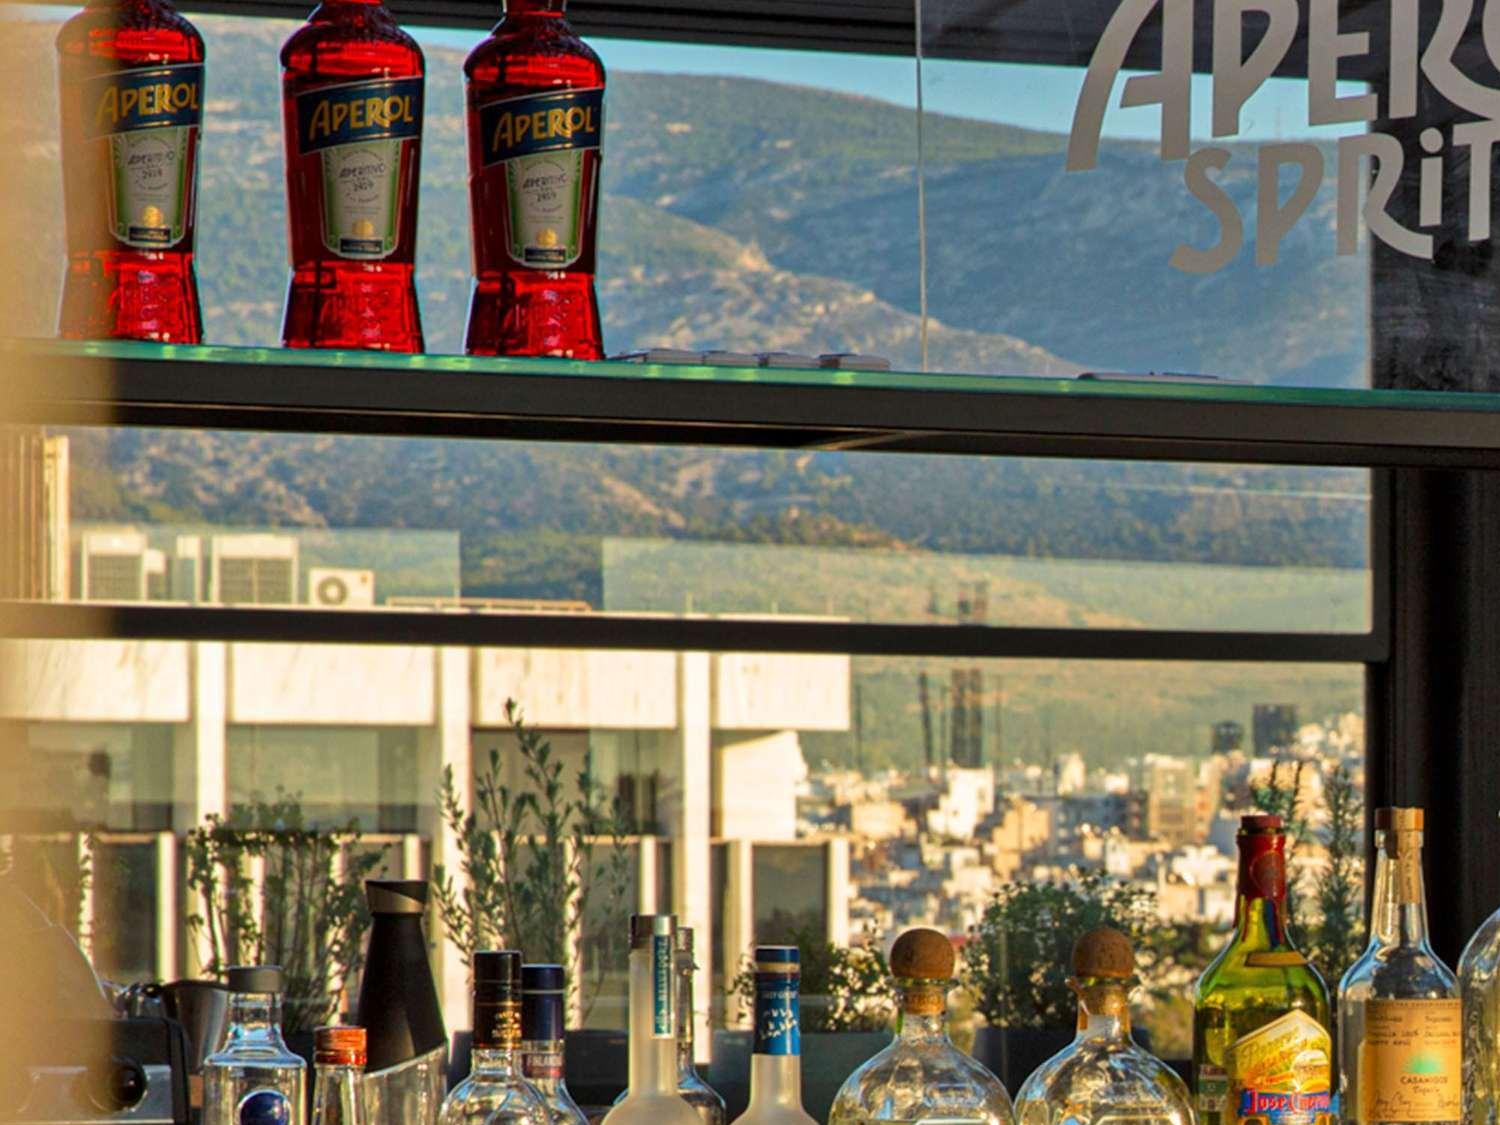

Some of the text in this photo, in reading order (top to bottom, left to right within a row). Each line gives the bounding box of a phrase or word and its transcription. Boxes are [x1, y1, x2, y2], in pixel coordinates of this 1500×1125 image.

[95, 83, 199, 126] APEROL
[309, 96, 413, 141] APEROL
[492, 107, 595, 153] APEROL
